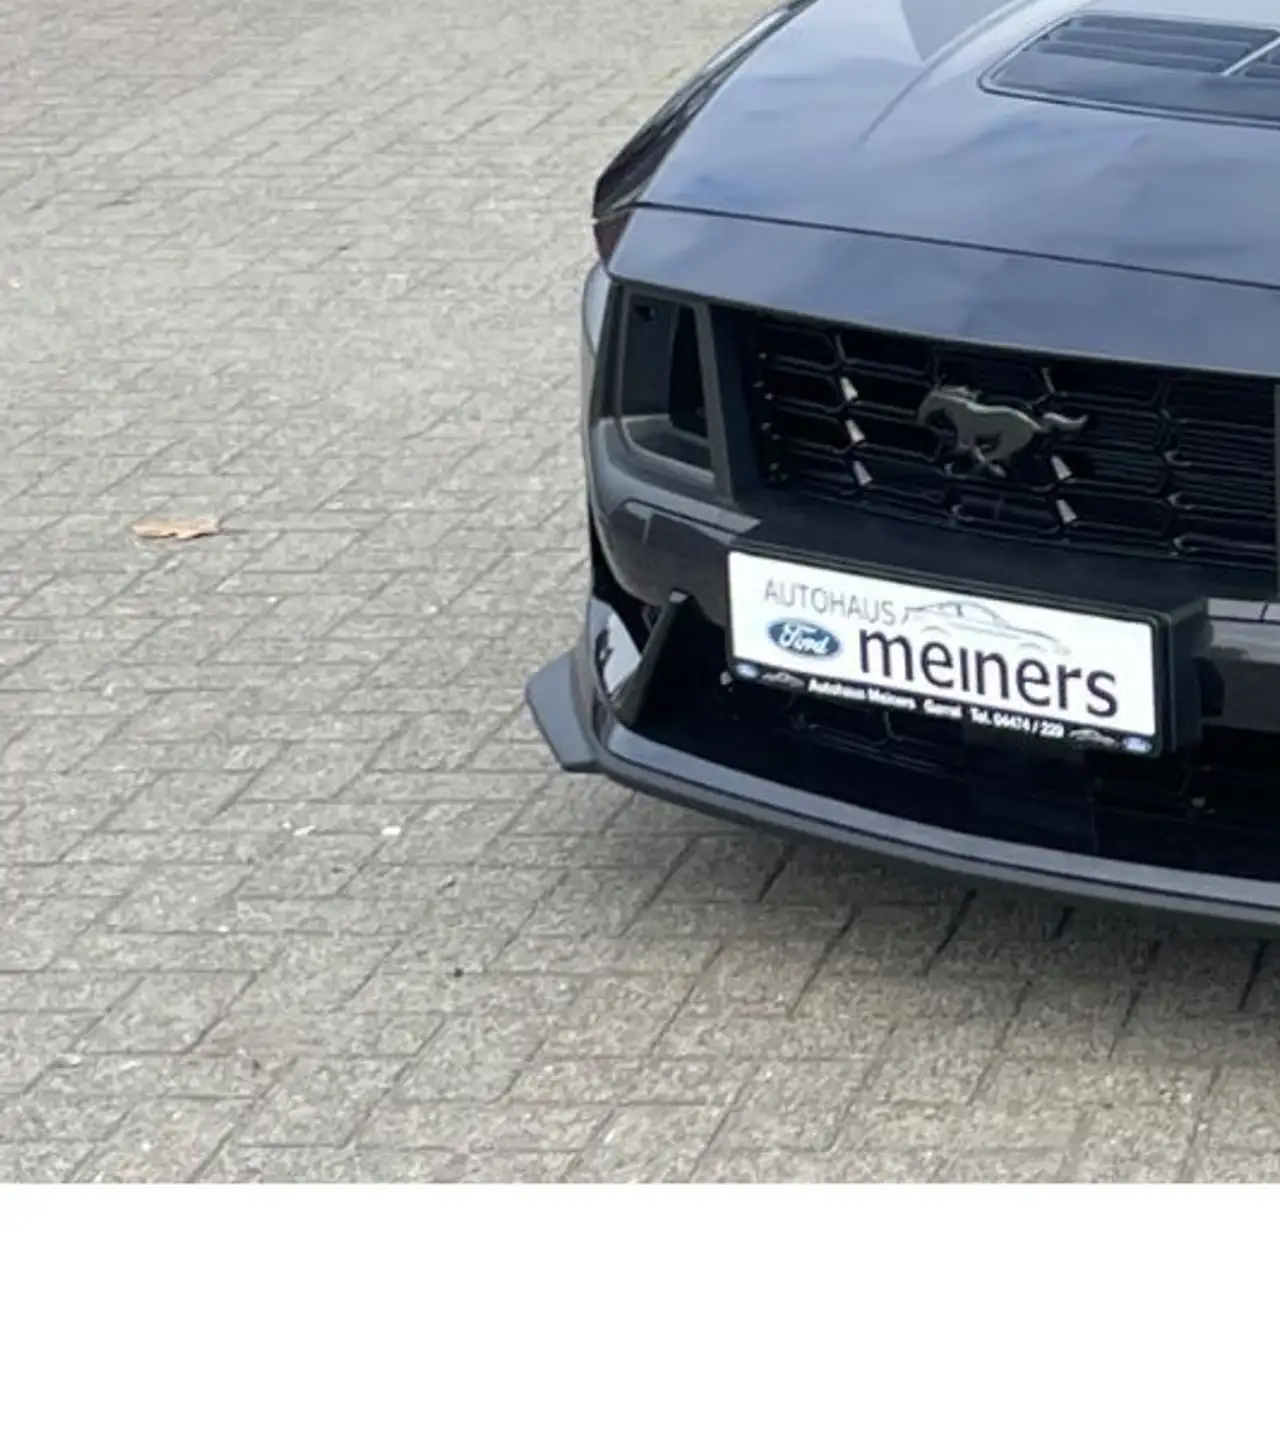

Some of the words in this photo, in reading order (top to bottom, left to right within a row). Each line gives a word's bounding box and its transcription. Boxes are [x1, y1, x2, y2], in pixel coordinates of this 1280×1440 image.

[763, 577, 896, 625] AUTOHAUS
[780, 621, 832, 656] Ford
[859, 627, 1120, 718] meiners
